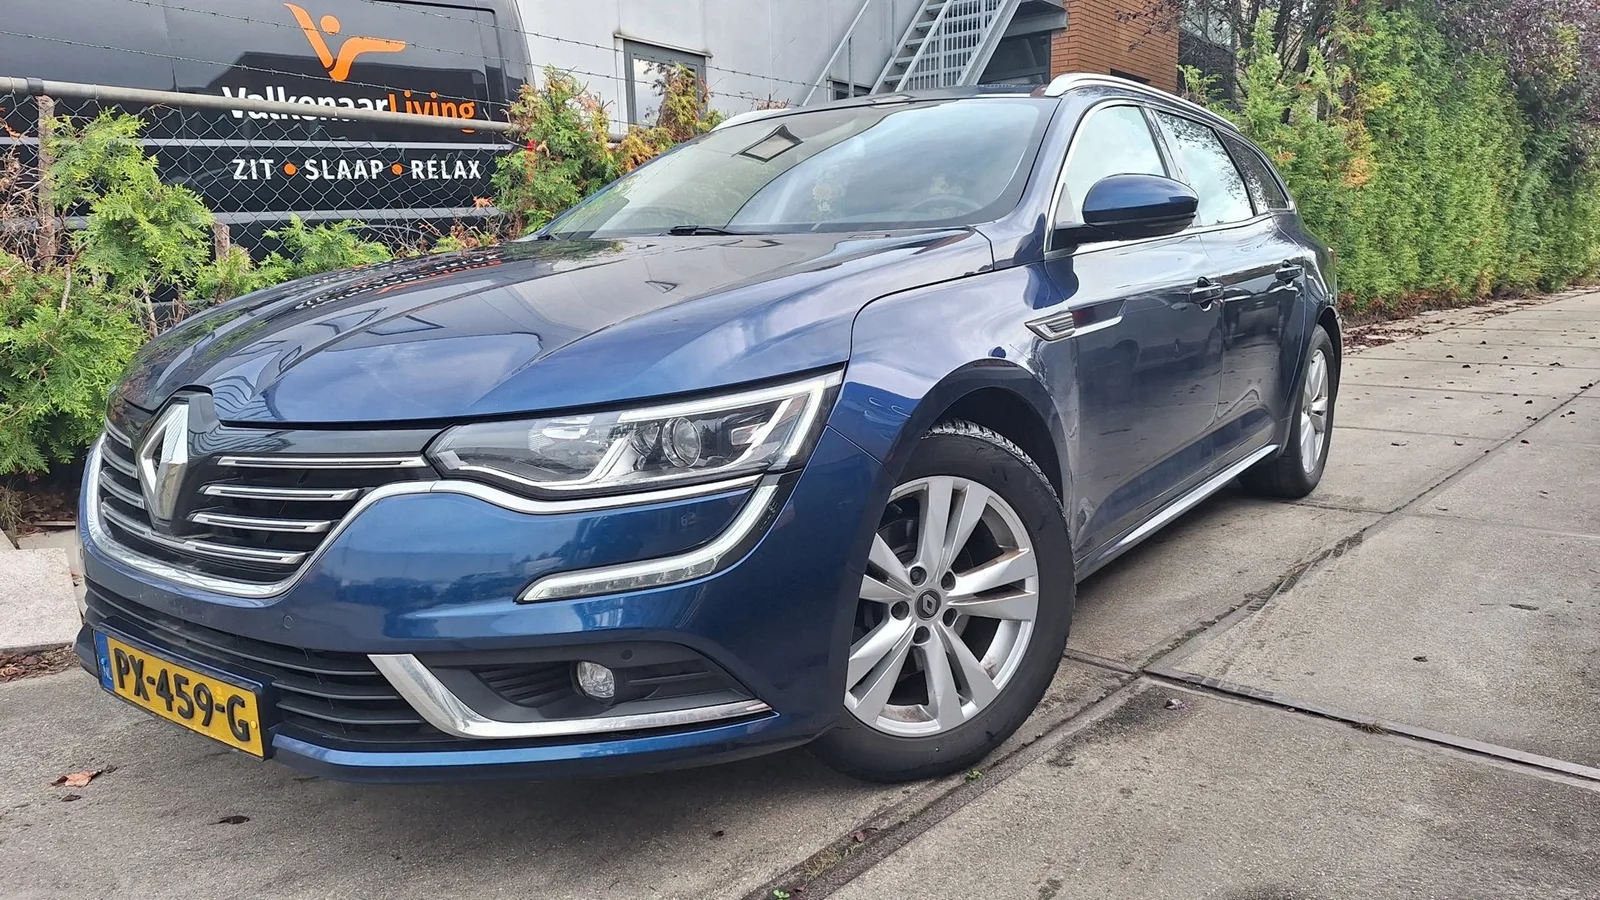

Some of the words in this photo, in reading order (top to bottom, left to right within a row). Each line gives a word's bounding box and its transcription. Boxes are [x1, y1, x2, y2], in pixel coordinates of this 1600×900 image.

[232, 159, 274, 180] ZIT
[305, 159, 384, 180] SLAAP
[411, 159, 482, 180] RELAX
[113, 647, 250, 742] PX-459-G
